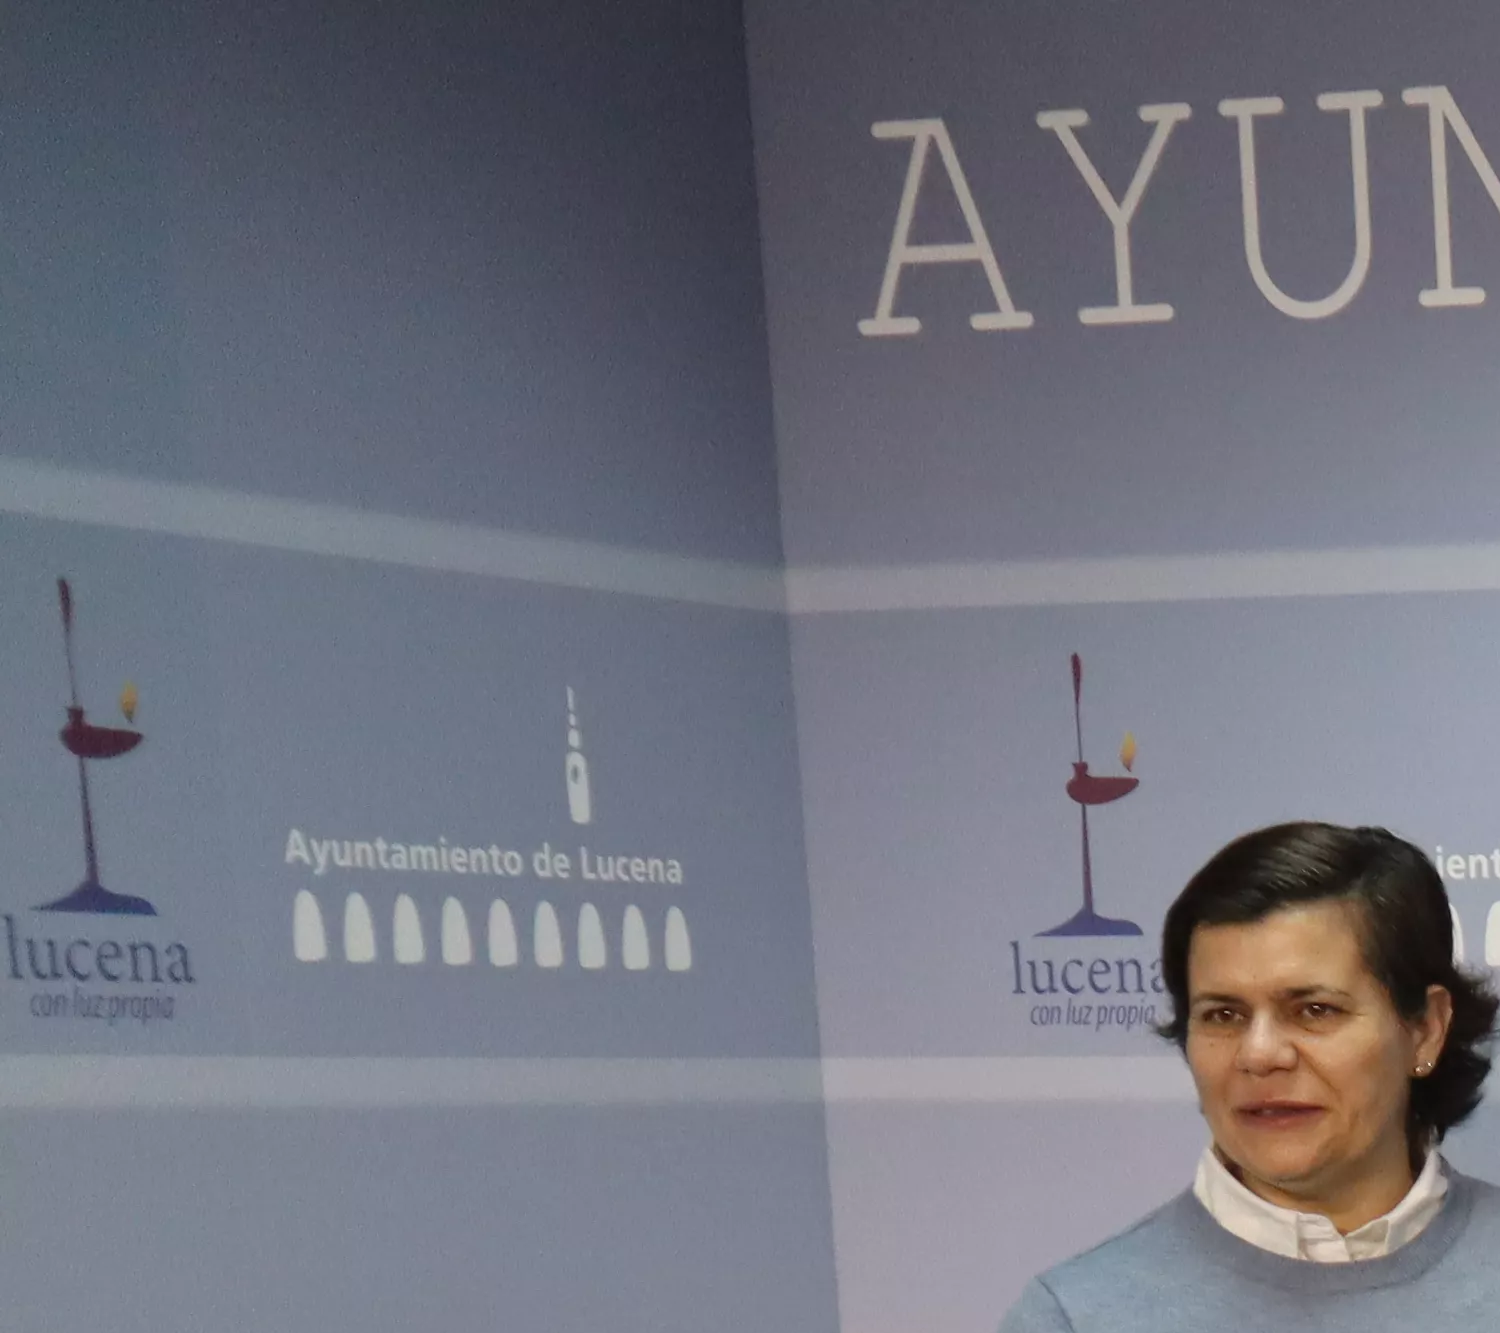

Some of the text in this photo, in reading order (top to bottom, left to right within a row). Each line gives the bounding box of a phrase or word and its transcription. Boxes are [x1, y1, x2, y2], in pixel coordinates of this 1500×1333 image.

[285, 828, 683, 884] Ayuntamiento de Lucena
[3, 913, 196, 984] lucena
[1030, 997, 1157, 1032] con luz propia
